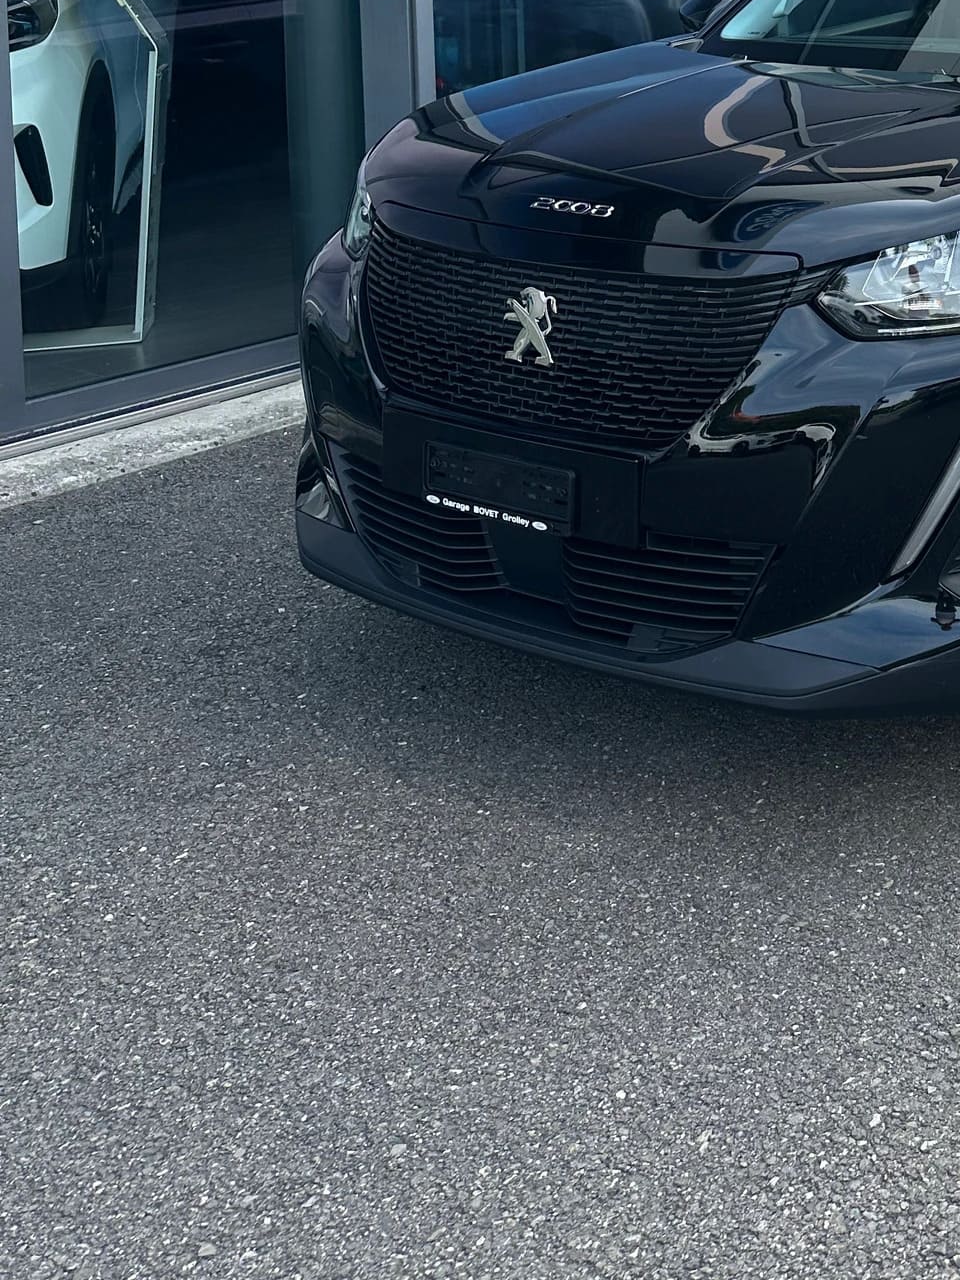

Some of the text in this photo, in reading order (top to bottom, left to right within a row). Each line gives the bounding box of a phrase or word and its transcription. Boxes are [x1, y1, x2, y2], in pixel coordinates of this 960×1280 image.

[530, 197, 615, 218] 2008
[442, 497, 470, 512] Garage
[473, 505, 499, 519] BOVET
[502, 512, 530, 528] Grolley
